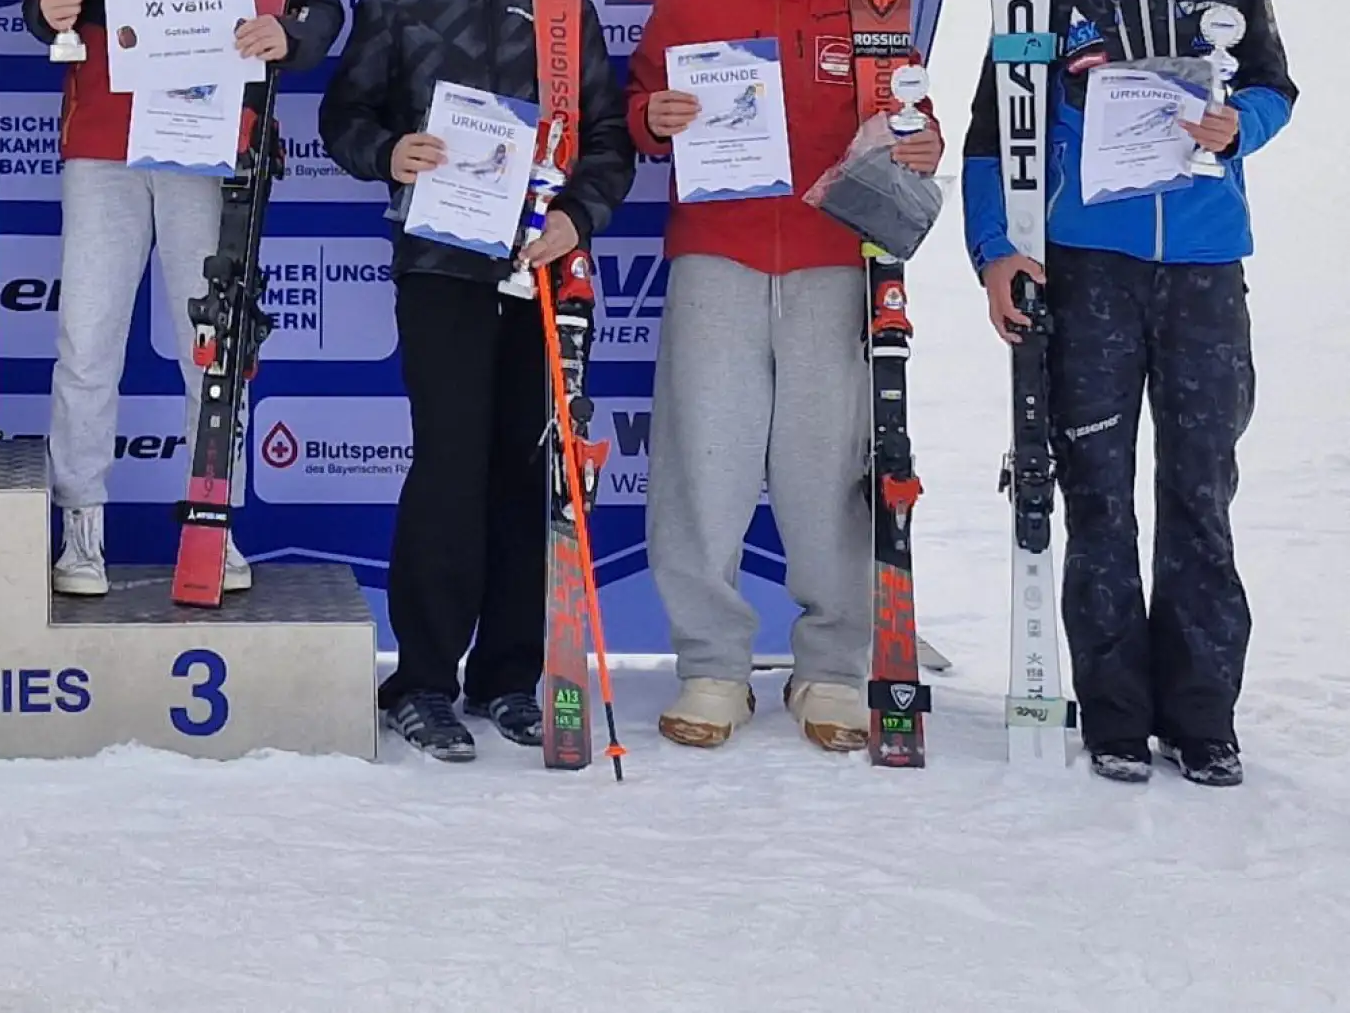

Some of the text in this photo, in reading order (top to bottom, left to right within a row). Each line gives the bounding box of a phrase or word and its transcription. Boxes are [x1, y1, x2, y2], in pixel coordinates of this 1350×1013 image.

[690, 68, 760, 86] URKUNDE
[451, 113, 516, 139] URKUNDE
[0, 137, 56, 154] KAMM
[325, 264, 392, 282] UNGS
[169, 649, 229, 737] 3
